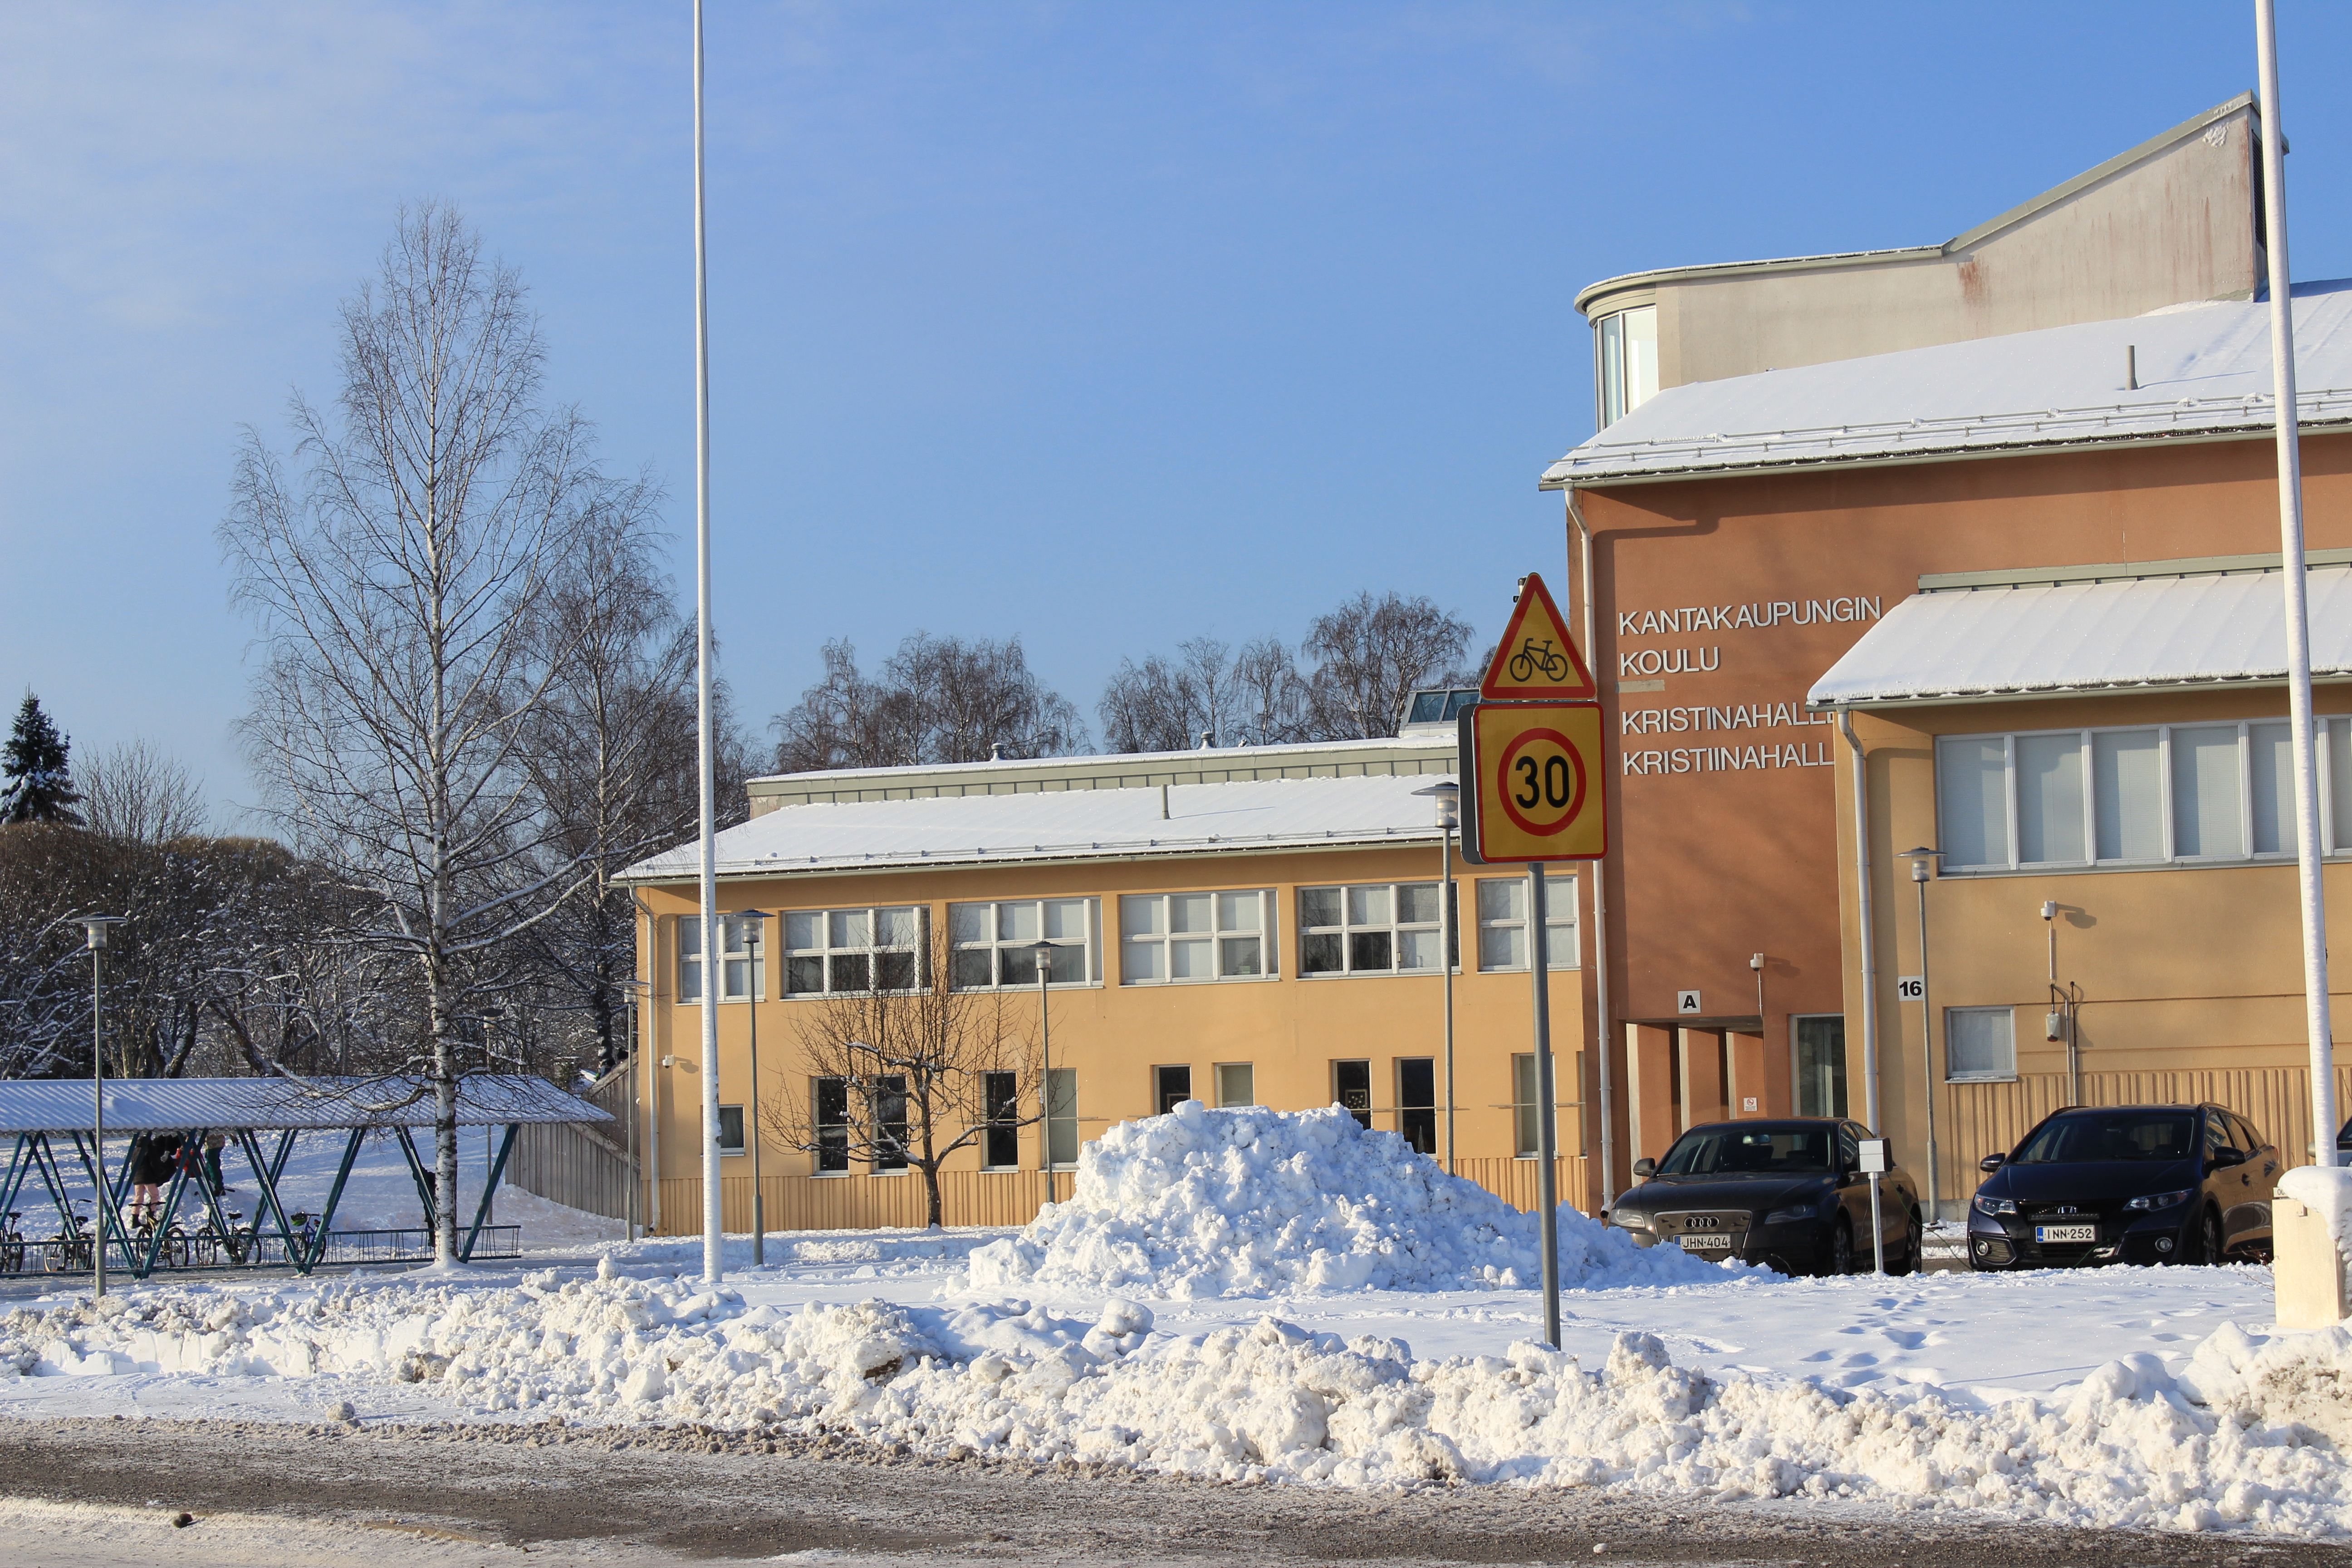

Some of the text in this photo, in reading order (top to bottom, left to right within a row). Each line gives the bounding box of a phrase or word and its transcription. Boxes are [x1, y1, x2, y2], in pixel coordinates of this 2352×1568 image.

[1619, 596, 1881, 635] KANTAKAUPUNGIN
[1621, 647, 1719, 676] KOULU
[1515, 755, 1569, 809] 30
[1899, 981, 1922, 996] 16
[1683, 995, 1697, 1009] A
[2048, 1228, 2092, 1240] INN-252
[1683, 1237, 1728, 1248] JHN-404
